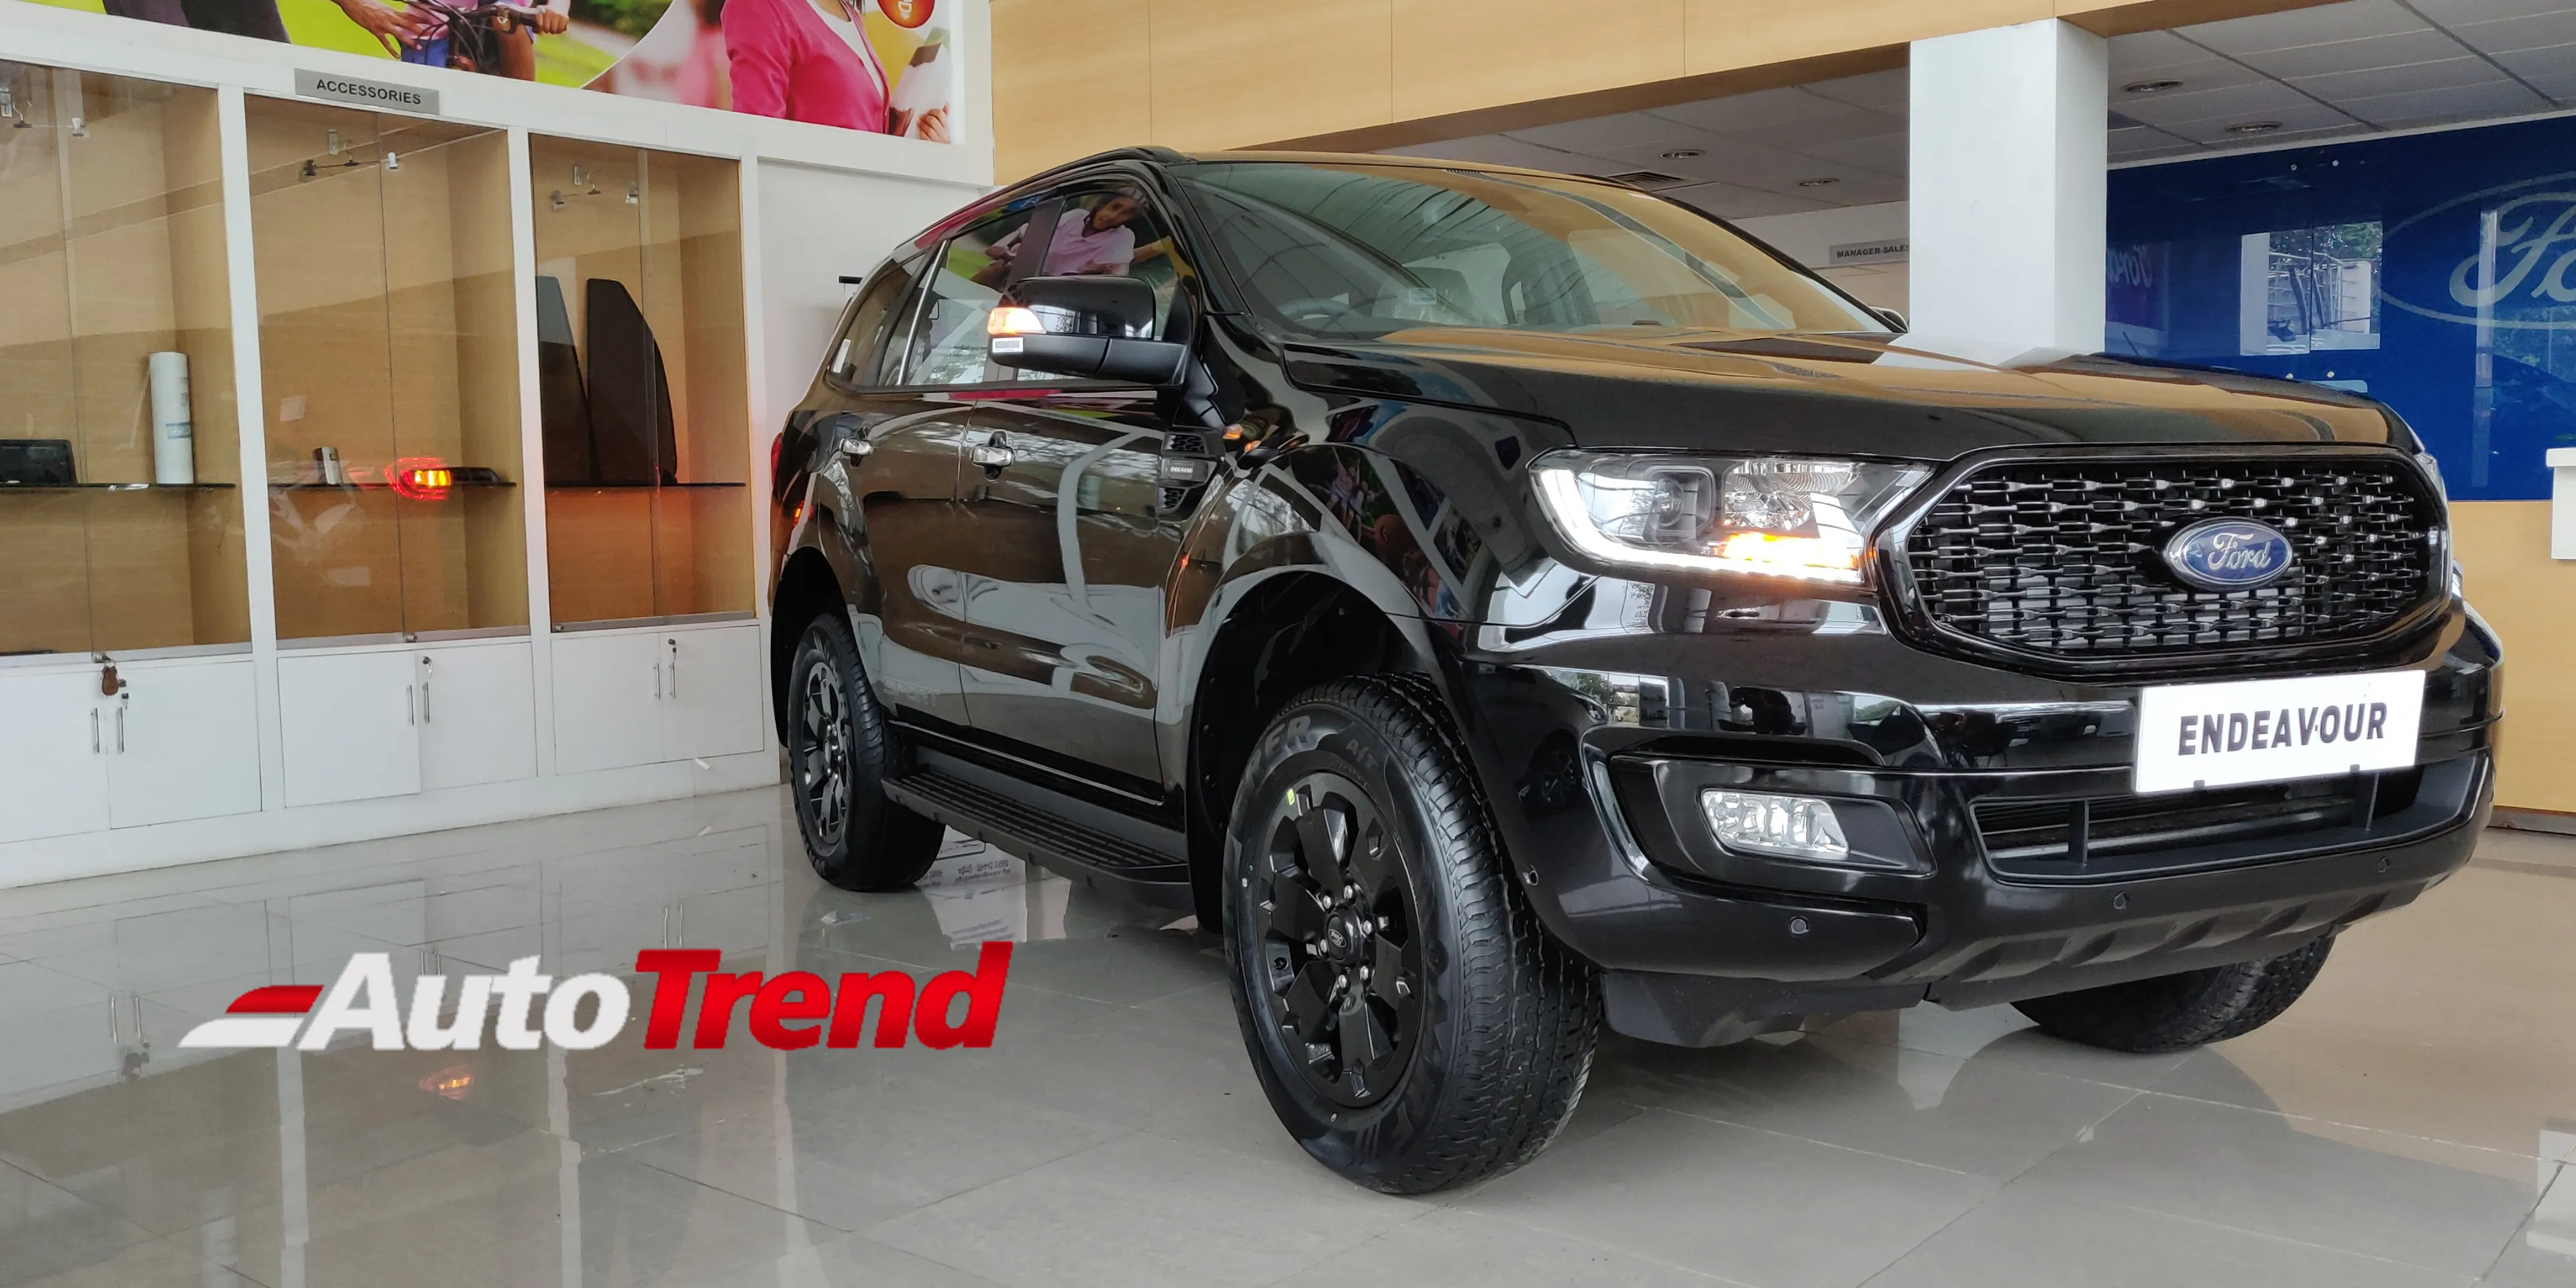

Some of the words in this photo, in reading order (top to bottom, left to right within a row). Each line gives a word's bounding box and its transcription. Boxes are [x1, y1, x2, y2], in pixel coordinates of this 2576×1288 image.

[316, 78, 421, 105] ACCESSORIES
[2208, 532, 2271, 570] Ford
[883, 677, 939, 707] SPORT
[2178, 701, 2388, 757] ENDEAVOUR
